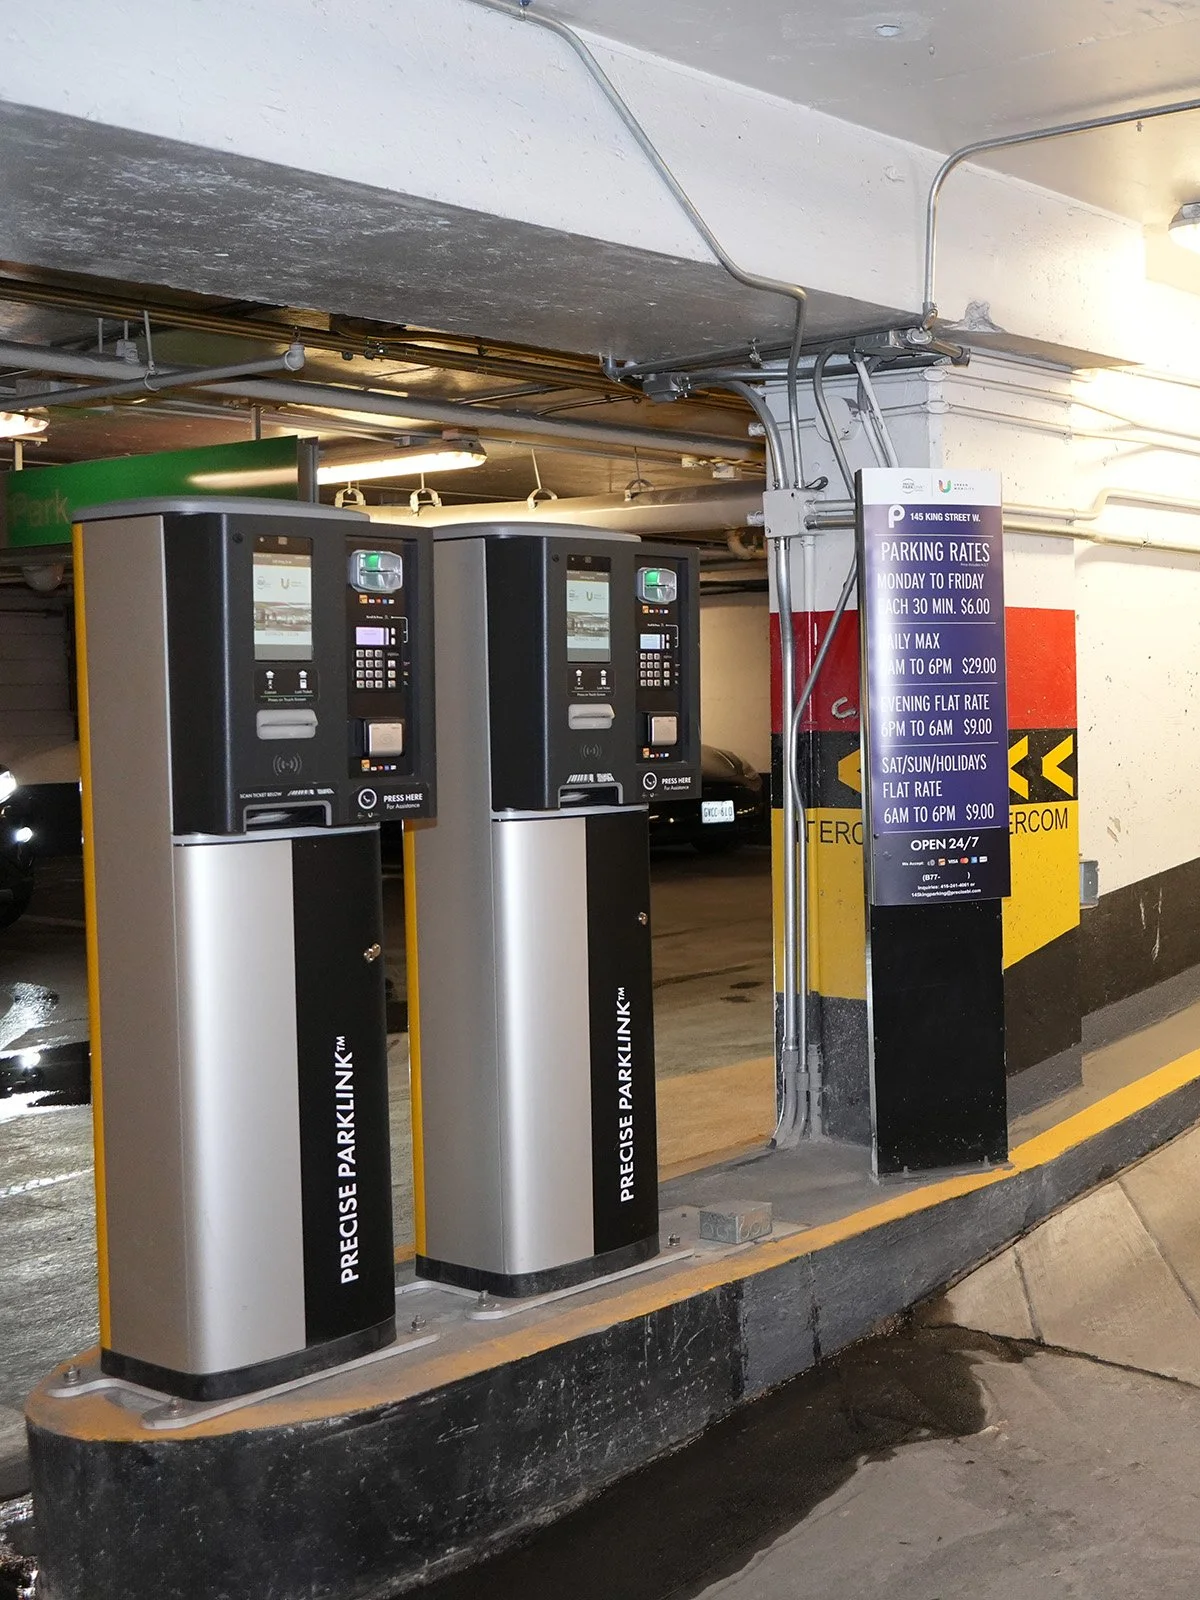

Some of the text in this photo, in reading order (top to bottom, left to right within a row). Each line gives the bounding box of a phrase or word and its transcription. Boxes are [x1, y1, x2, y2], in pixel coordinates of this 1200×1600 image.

[910, 513, 981, 522] 145 KING STREET W.
[881, 542, 990, 563] PARKING RATES
[877, 573, 984, 590] MONDAY TO FRIDAY
[913, 598, 928, 615] 30
[932, 598, 957, 615] MIN.
[961, 598, 990, 615] $6.00
[915, 633, 940, 649] MAX
[909, 659, 924, 674] TO
[929, 658, 952, 674] 6PM
[962, 657, 996, 675] $29.00
[881, 694, 990, 712] EVENING FLAT RATE
[881, 718, 992, 737] 6PM TO 6AM $9.00
[882, 754, 987, 774] SAT/SUN/HOLIDAYS
[662, 777, 677, 785] PRESS
[883, 781, 942, 798] FLAT RATE
[405, 793, 423, 801] HERE
[884, 803, 994, 824] 6AM TO 6PM $9.00
[911, 836, 979, 851] OPEN 24/7
[618, 1115, 634, 1203] PRECISE
[338, 1183, 359, 1284] PRECISE
